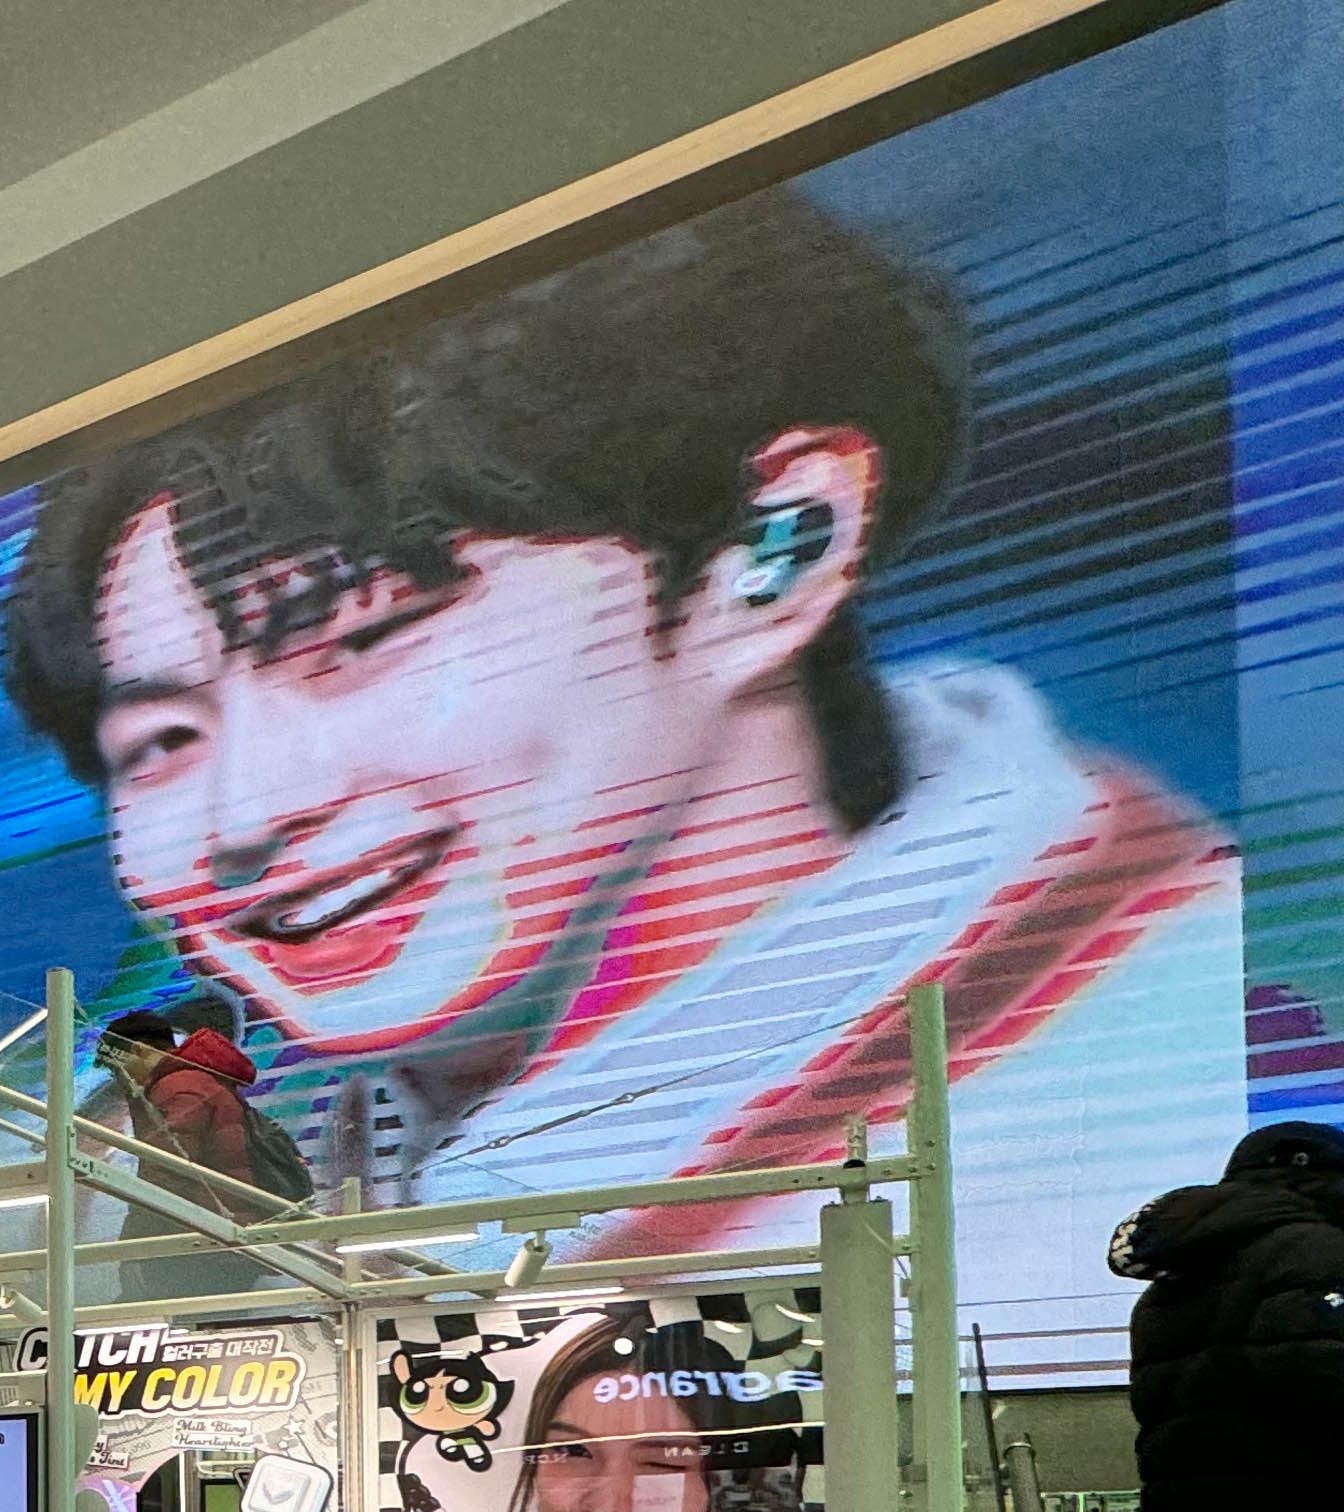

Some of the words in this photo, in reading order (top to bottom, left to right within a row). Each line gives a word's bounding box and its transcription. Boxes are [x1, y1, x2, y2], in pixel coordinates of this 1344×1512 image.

[19, 1329, 163, 1370] CTCH
[74, 1370, 138, 1411] MY
[143, 1361, 297, 1410] COLOR
[176, 1420, 206, 1434] Milk
[210, 1420, 248, 1436] Bling
